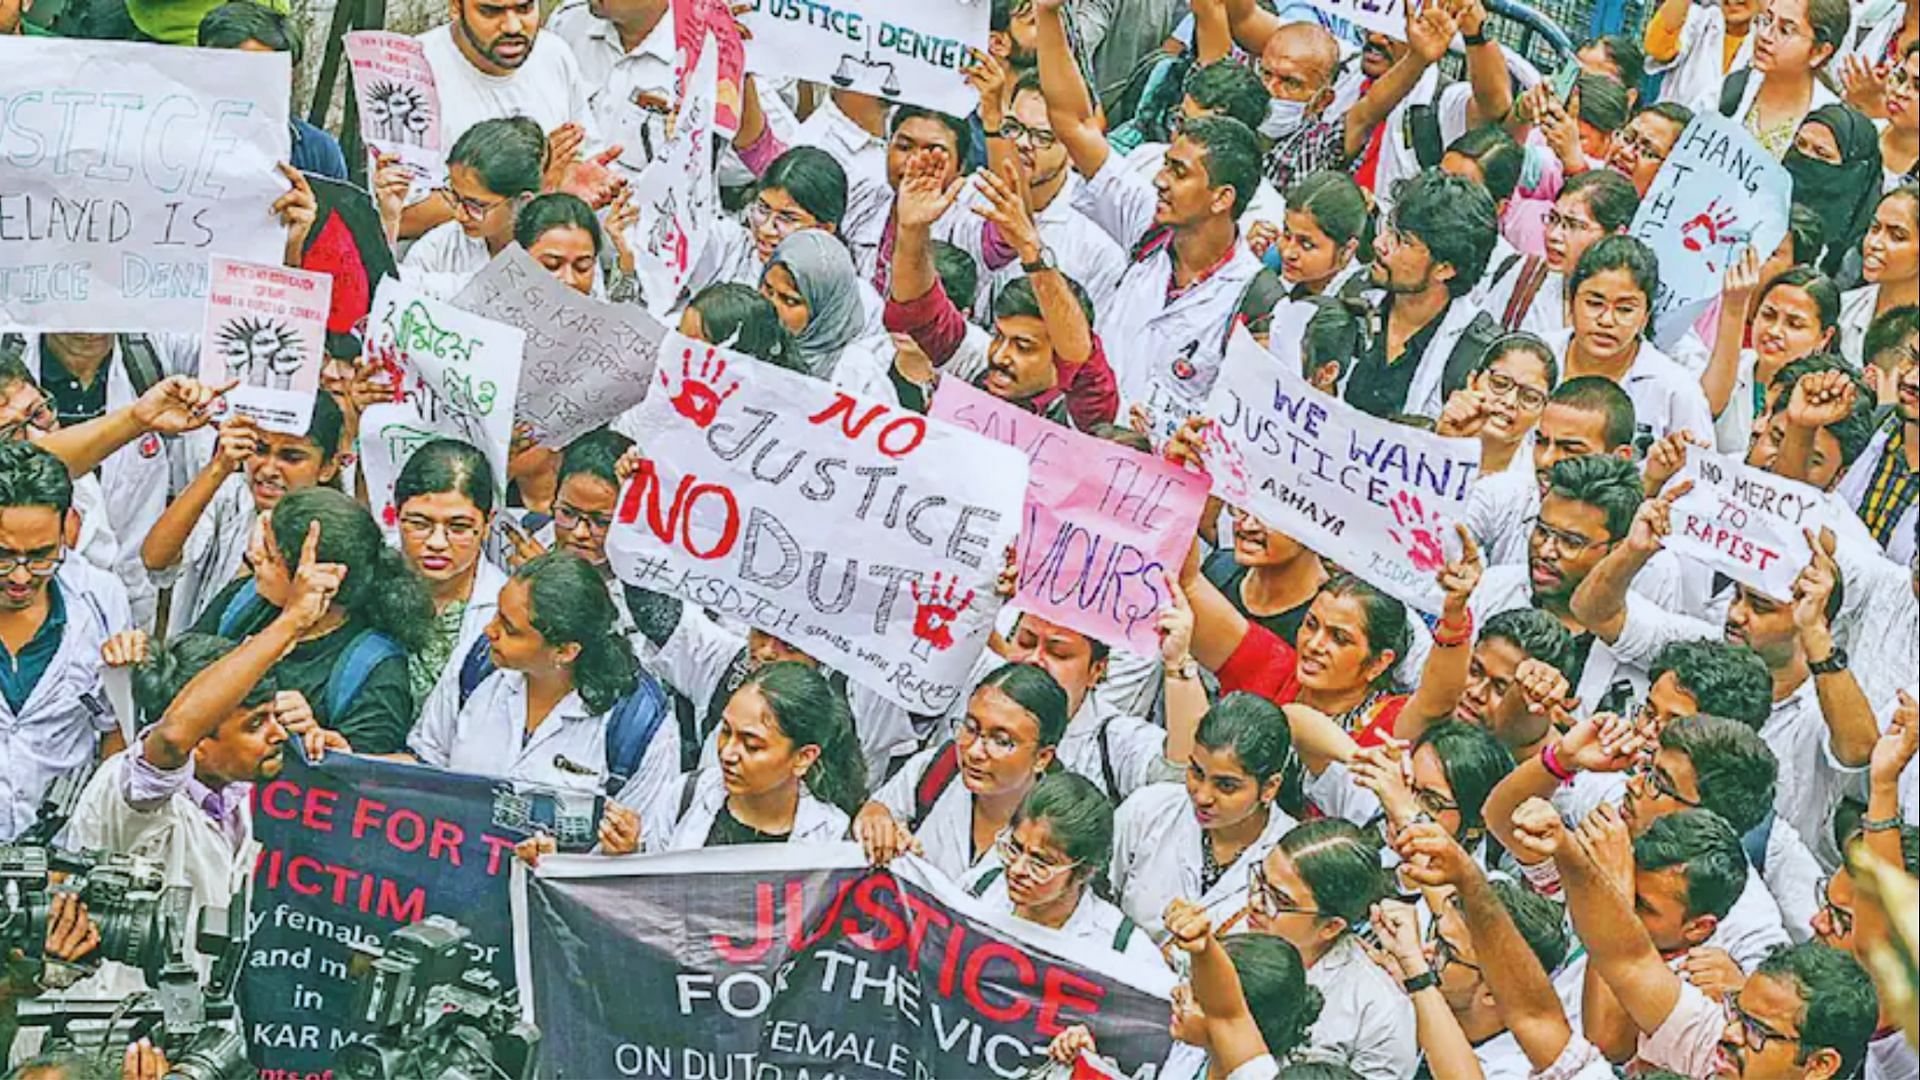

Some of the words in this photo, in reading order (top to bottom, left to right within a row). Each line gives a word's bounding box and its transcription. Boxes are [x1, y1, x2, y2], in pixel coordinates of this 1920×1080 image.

[0, 90, 254, 201] STICE
[1683, 122, 1765, 198] HANG
[153, 201, 214, 248] IS
[808, 391, 927, 459] NO
[1219, 388, 1390, 508] JUSTICE
[1273, 378, 1328, 440] WE
[1349, 428, 1478, 501] WANT
[618, 458, 741, 561] NO
[706, 405, 1002, 569] JUSTICE
[1098, 456, 1186, 532] THE
[1699, 459, 1723, 485] NO
[1732, 475, 1815, 526] MERCY
[1715, 498, 1748, 530] TO
[1683, 514, 1780, 571] RAPIST
[351, 797, 465, 867] FOR
[480, 833, 517, 876] T
[249, 946, 312, 970] and
[710, 869, 1107, 1039] JUSTICE
[814, 949, 922, 1028] THE
[293, 984, 324, 1011] in
[253, 1022, 320, 1050] KAR
[614, 1043, 671, 1078] ON
[683, 1049, 758, 1080] DUT
[763, 1020, 912, 1078] EMALE
